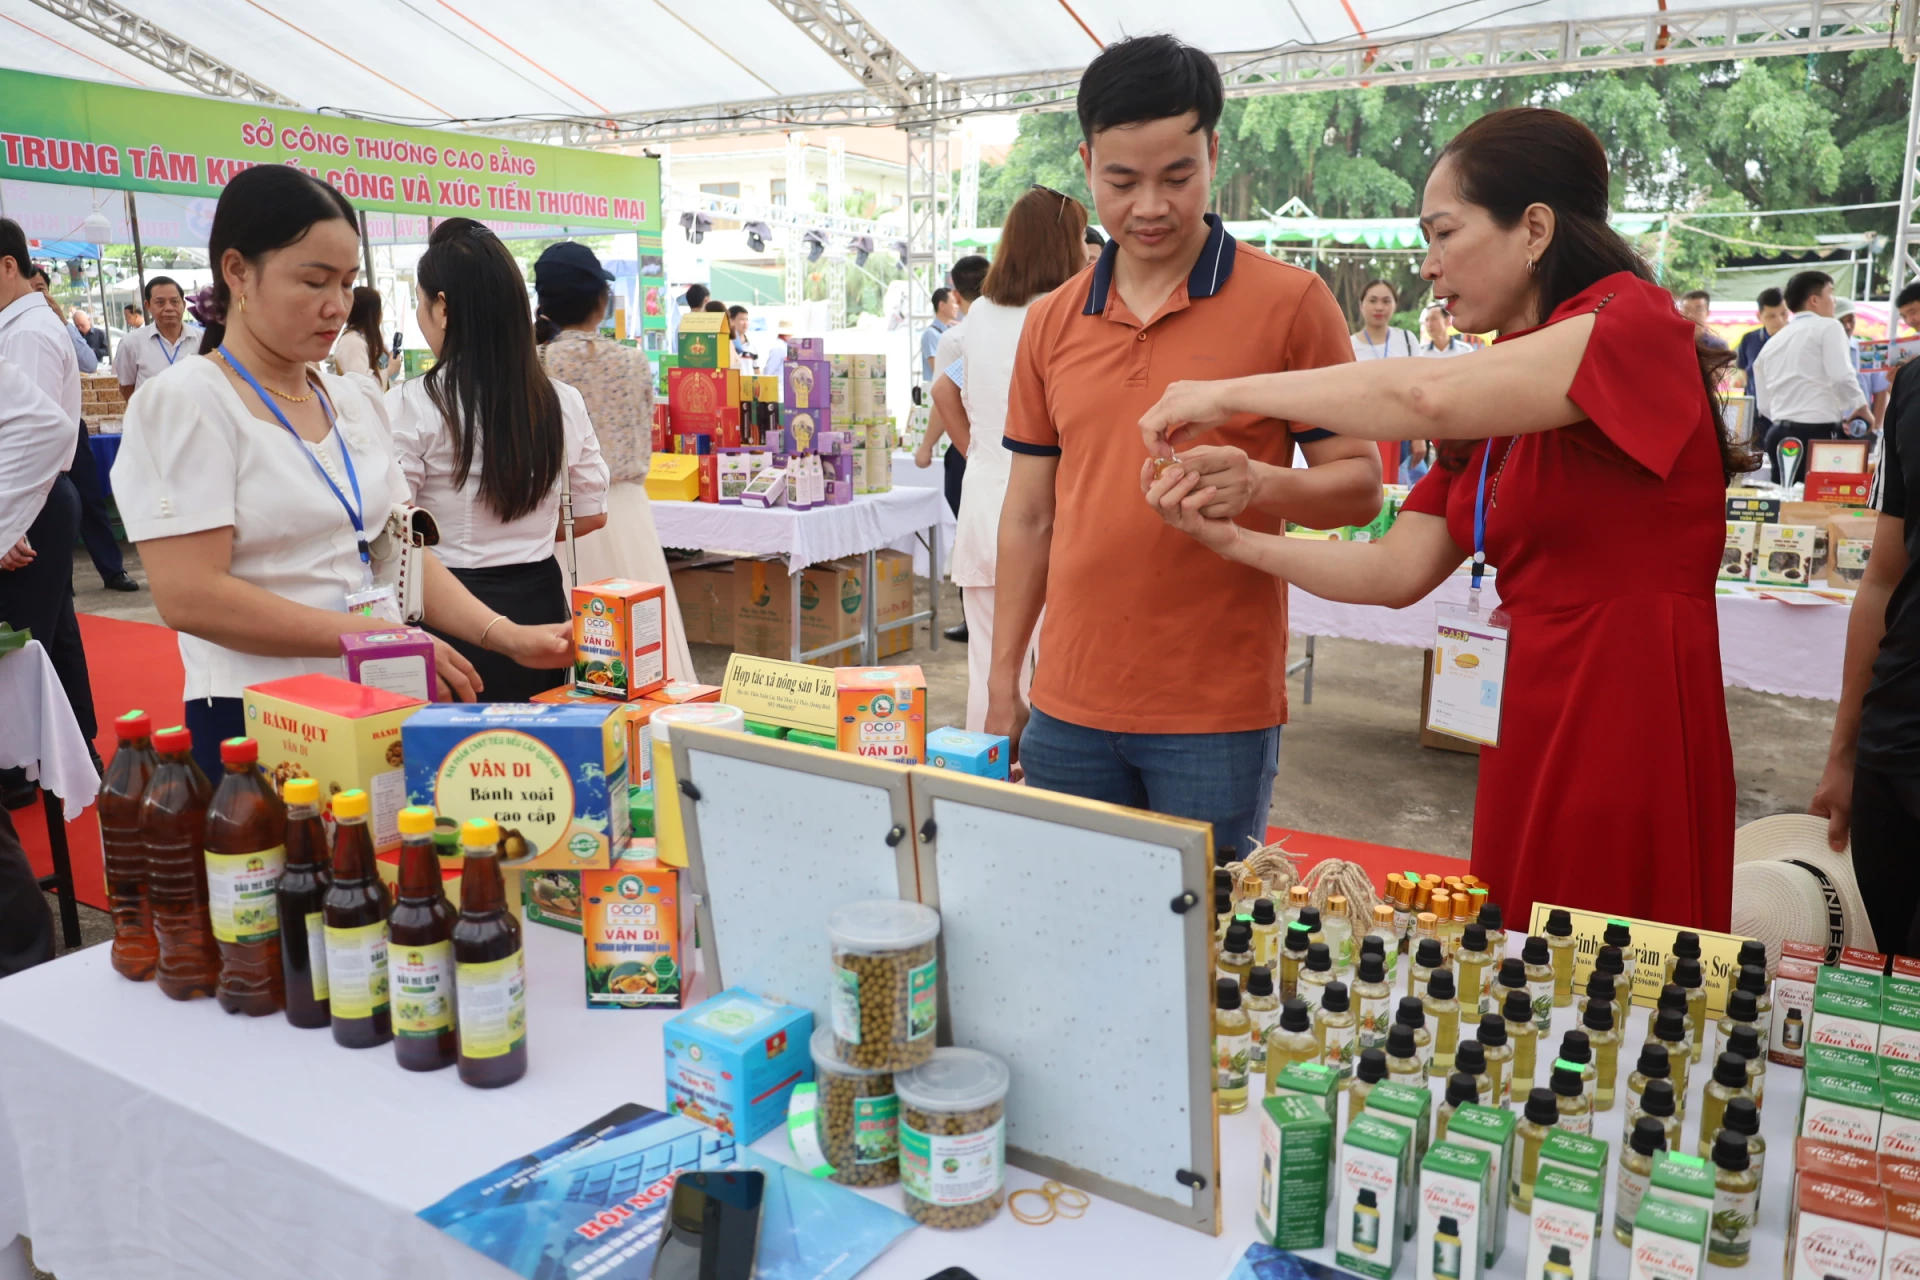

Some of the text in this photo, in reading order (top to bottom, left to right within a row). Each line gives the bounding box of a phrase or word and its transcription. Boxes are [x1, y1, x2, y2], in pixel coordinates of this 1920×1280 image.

[242, 118, 536, 177] SỞ CÔNG THƯƠNG CAO BẰNG
[1, 133, 120, 176] TRUNG
[128, 146, 198, 184] TÂM
[327, 167, 395, 201] CÔNG
[401, 174, 432, 204] VÀ
[438, 178, 481, 209] XÚC
[487, 181, 531, 212] TIẾN
[537, 190, 608, 216] THƯƠNG
[614, 198, 646, 226] MẠI
[587, 619, 609, 628] OCOP
[584, 635, 614, 647] VÂN DI
[1443, 628, 1470, 643] CARD
[732, 666, 750, 686] Hợp
[752, 669, 764, 685] tác
[765, 672, 776, 687] xã
[776, 673, 797, 695] nông
[798, 677, 812, 693] sản
[815, 679, 831, 696] Vân
[263, 711, 328, 743] BÁNH QUY
[372, 727, 398, 740] BÁNH
[864, 722, 901, 732] OCOP
[282, 739, 308, 756] VÂN DI
[858, 744, 908, 756] VÂN DI
[469, 759, 531, 777] VÂN DI
[471, 786, 554, 801] Bánh xoài
[494, 806, 556, 825] cao cấp
[611, 905, 651, 915] OCOP
[1821, 876, 1843, 965] CELINE
[605, 928, 659, 940] VÂN DI
[1575, 932, 1731, 978] inh ràm Sơ
[1576, 957, 1592, 966] Xuân
[1815, 1031, 1872, 1052] Thu Sơn
[1880, 1045, 1909, 1059] Thu
[1807, 1119, 1872, 1143] Thu Sơn
[1882, 1136, 1915, 1153] Thu
[574, 1168, 685, 1240] HỘI NGH
[1534, 1216, 1590, 1241] Thu Sơn
[1801, 1236, 1876, 1266] Thu Sơn
[1637, 1247, 1694, 1274] Thu Sơn
